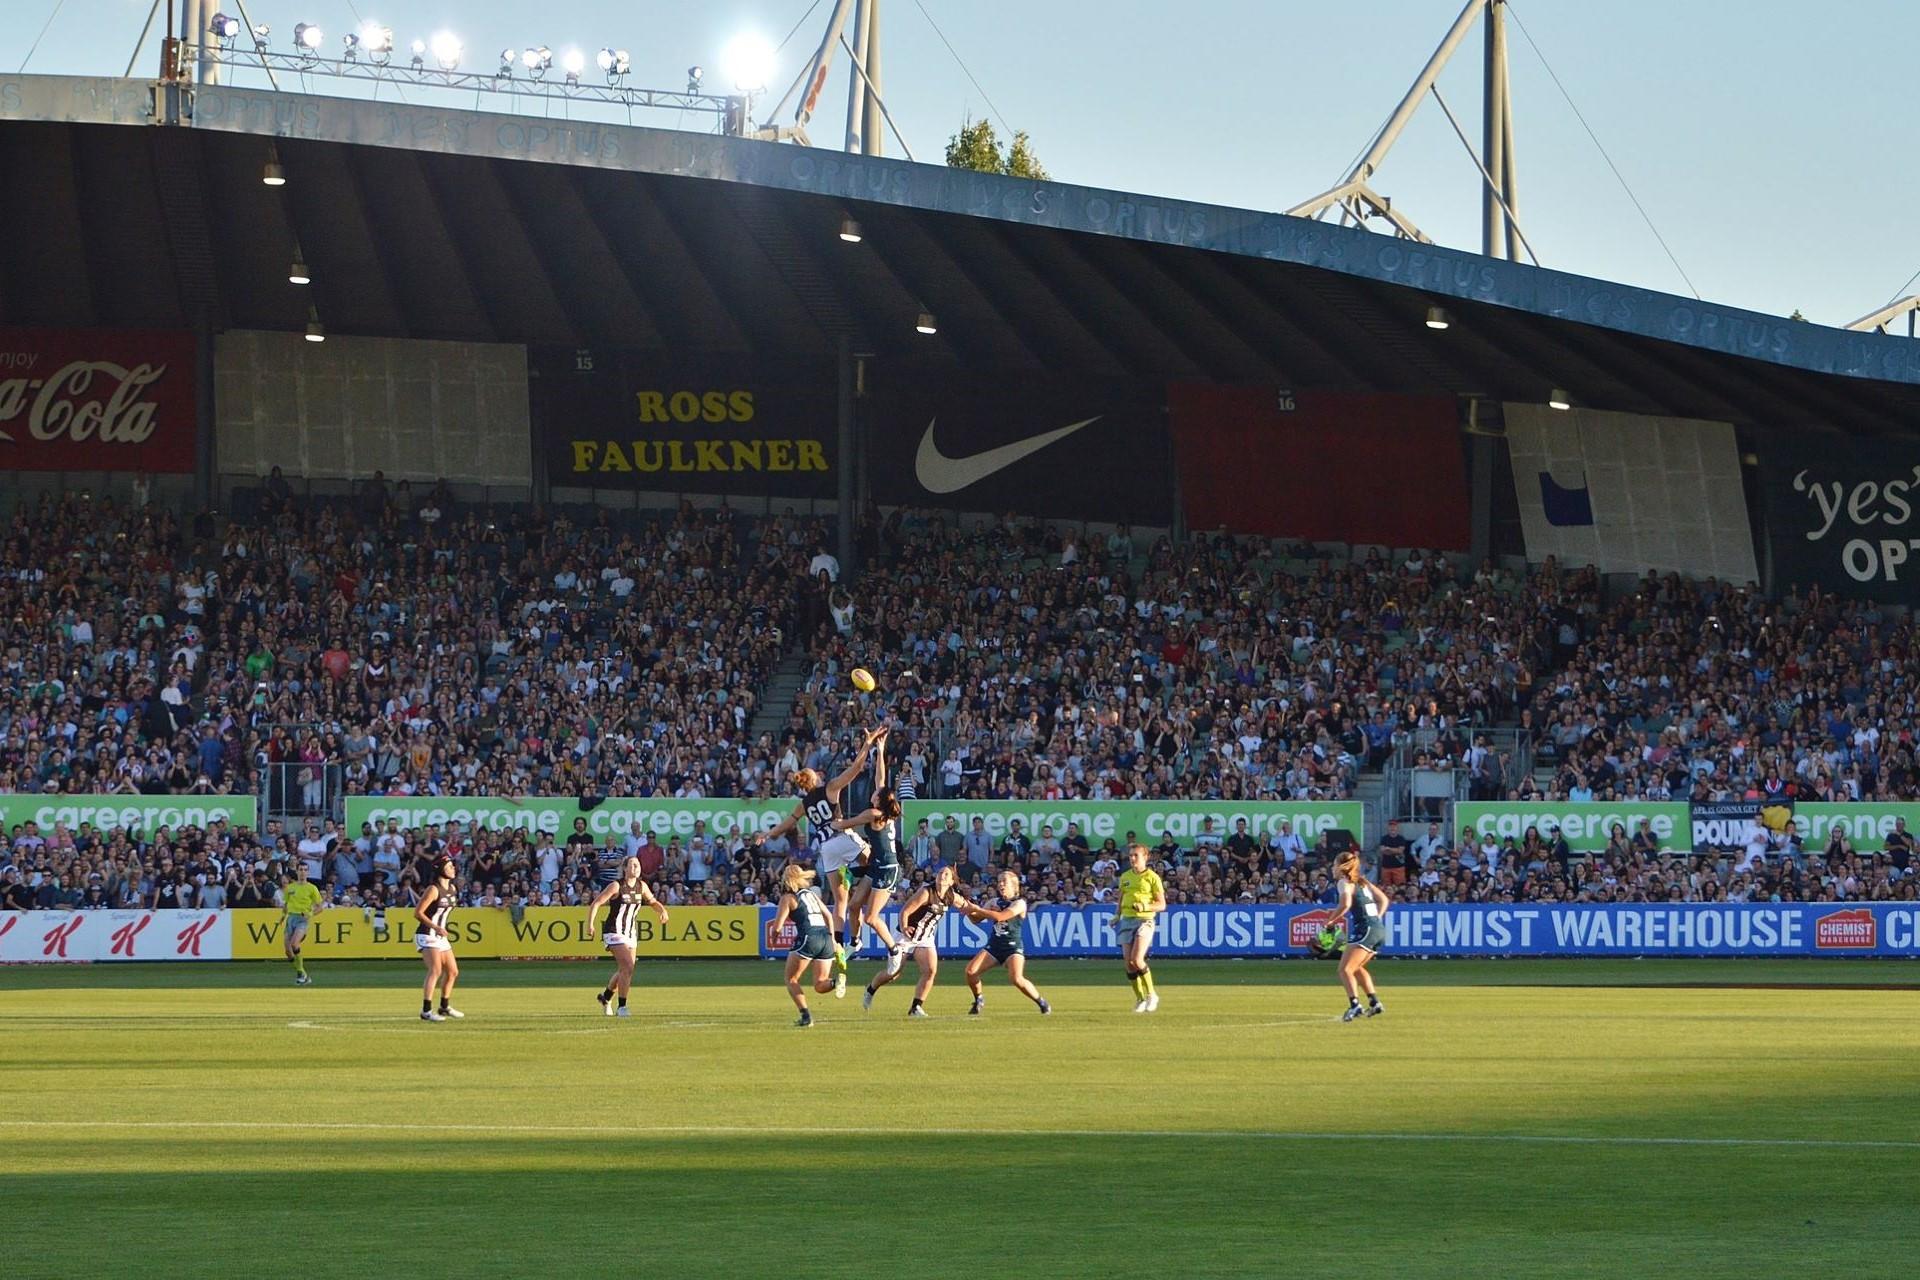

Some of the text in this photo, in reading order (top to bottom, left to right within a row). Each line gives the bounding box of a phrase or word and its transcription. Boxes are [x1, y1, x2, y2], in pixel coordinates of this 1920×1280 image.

[495, 121, 620, 158] OPTUS
[1085, 198, 1206, 240] OPTUS
[1376, 245, 1497, 293] OPTUS
[1668, 306, 1790, 353] OPTUS
[576, 357, 593, 370] 15
[636, 391, 754, 422] ROSS
[1278, 397, 1295, 411] 16
[571, 439, 829, 472] FAULKNER
[590, 810, 782, 834] careerone
[807, 800, 833, 825] 60
[43, 915, 84, 957] K
[111, 914, 151, 957] K
[177, 914, 217, 956] K
[247, 921, 482, 943] WLF BLSS
[637, 920, 745, 941] BLASS
[1027, 911, 1275, 948] WARHOUSE
[1384, 909, 1802, 948] HEMIST WAREHOUSE
[1820, 923, 1872, 936] CHEMIST
